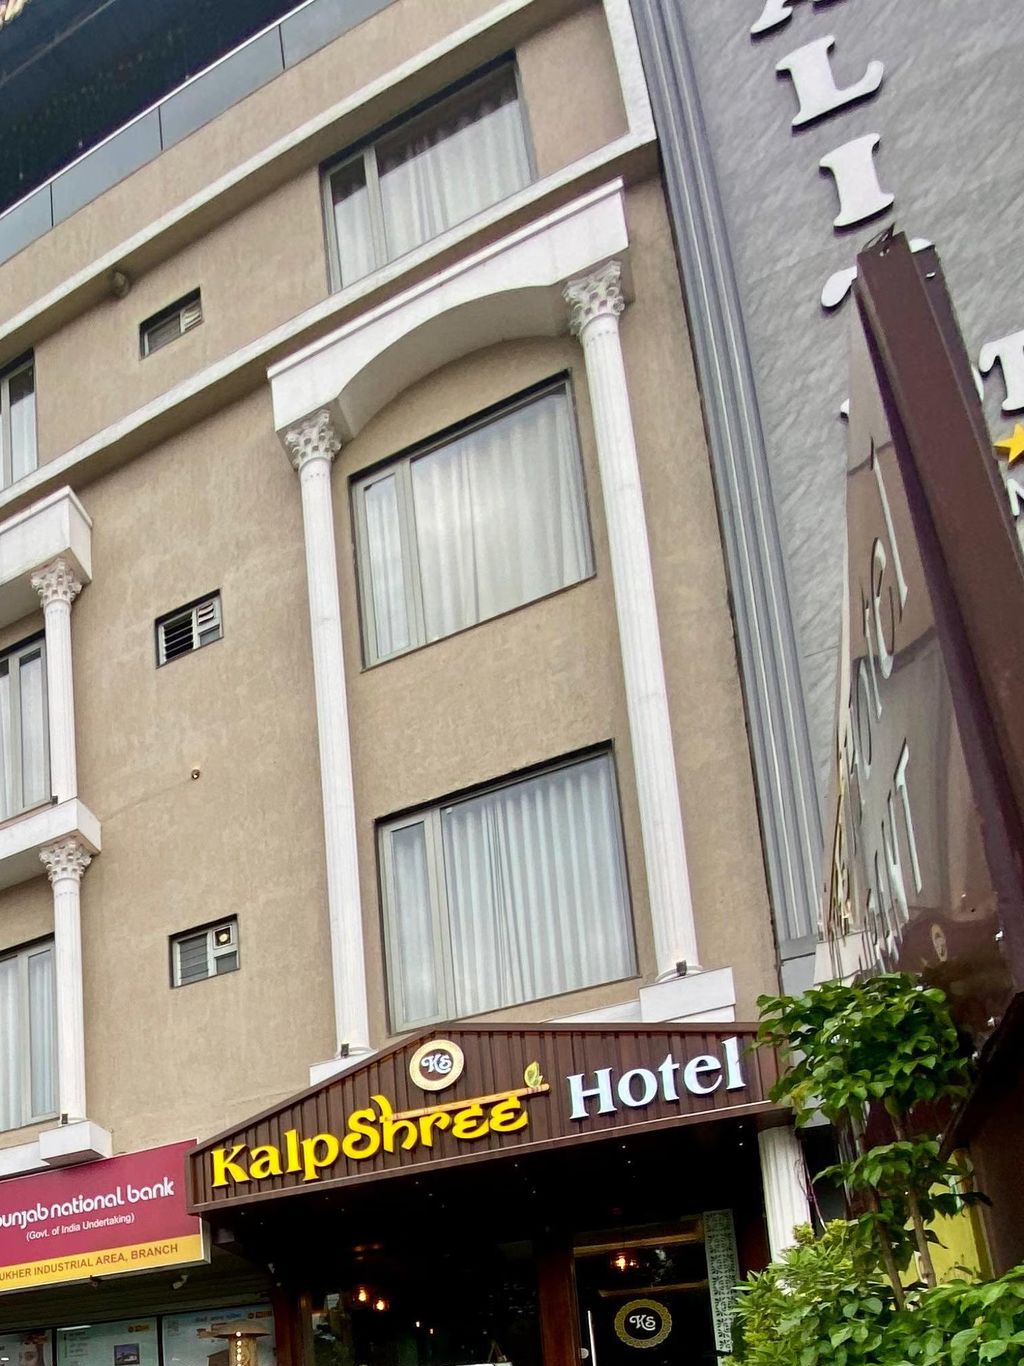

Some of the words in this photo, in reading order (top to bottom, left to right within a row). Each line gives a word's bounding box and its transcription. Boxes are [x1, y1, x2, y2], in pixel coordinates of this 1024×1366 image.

[566, 1036, 746, 1120] Hotel
[50, 1186, 125, 1218] national
[126, 1176, 175, 1203] bank
[26, 1229, 50, 1242] (Govt.
[51, 1225, 60, 1236] of
[61, 1223, 80, 1234] India
[82, 1213, 135, 1231] Undertaking)
[34, 1256, 93, 1276] INDUSTRIAL
[95, 1252, 127, 1267] AREA,
[131, 1243, 178, 1260] BRANCH
